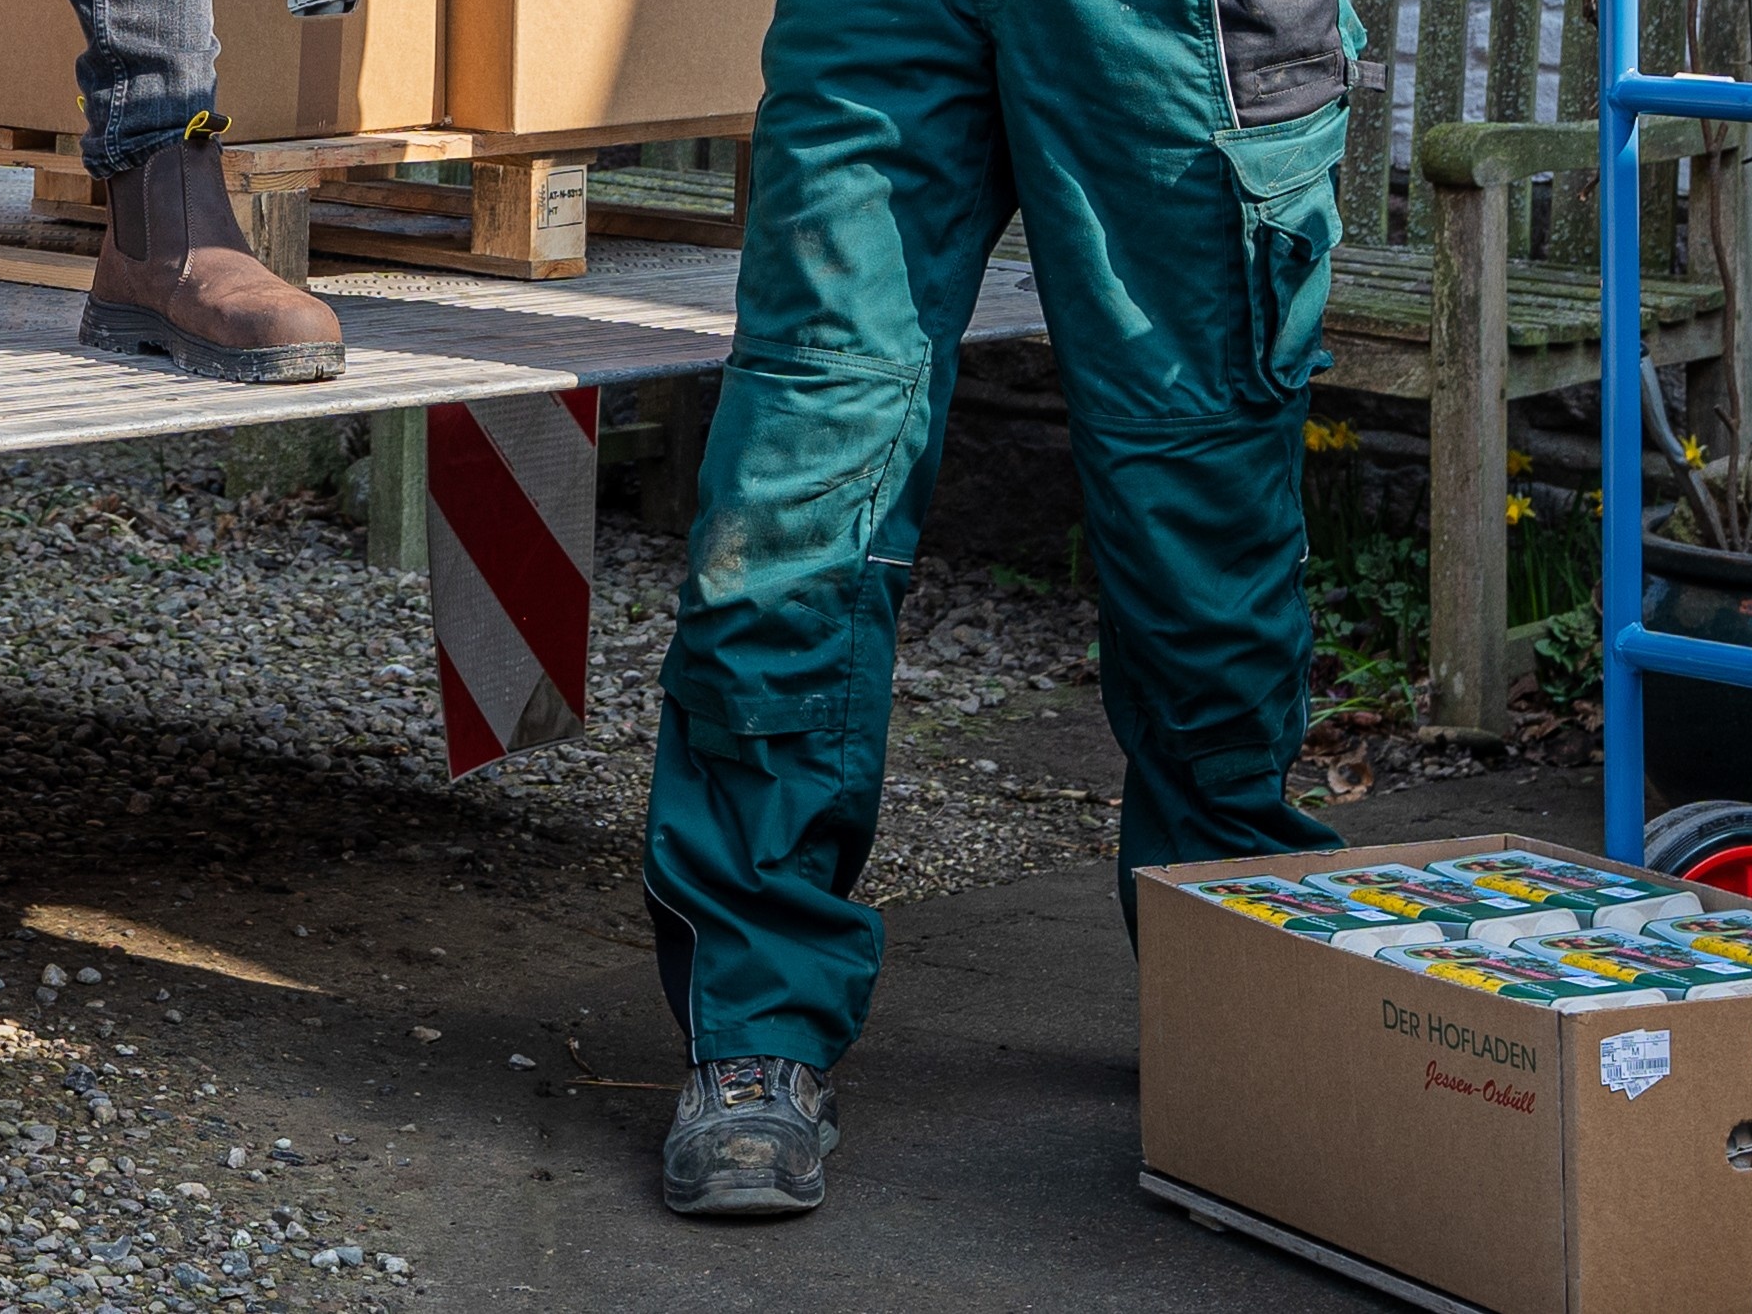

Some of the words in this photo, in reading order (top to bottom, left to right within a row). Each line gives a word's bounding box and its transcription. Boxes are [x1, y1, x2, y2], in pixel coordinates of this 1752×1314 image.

[1382, 999, 1421, 1039] DER
[1428, 1013, 1537, 1073] HOFLADEN
[1425, 1060, 1536, 1114] Jessen-Oxbüll
